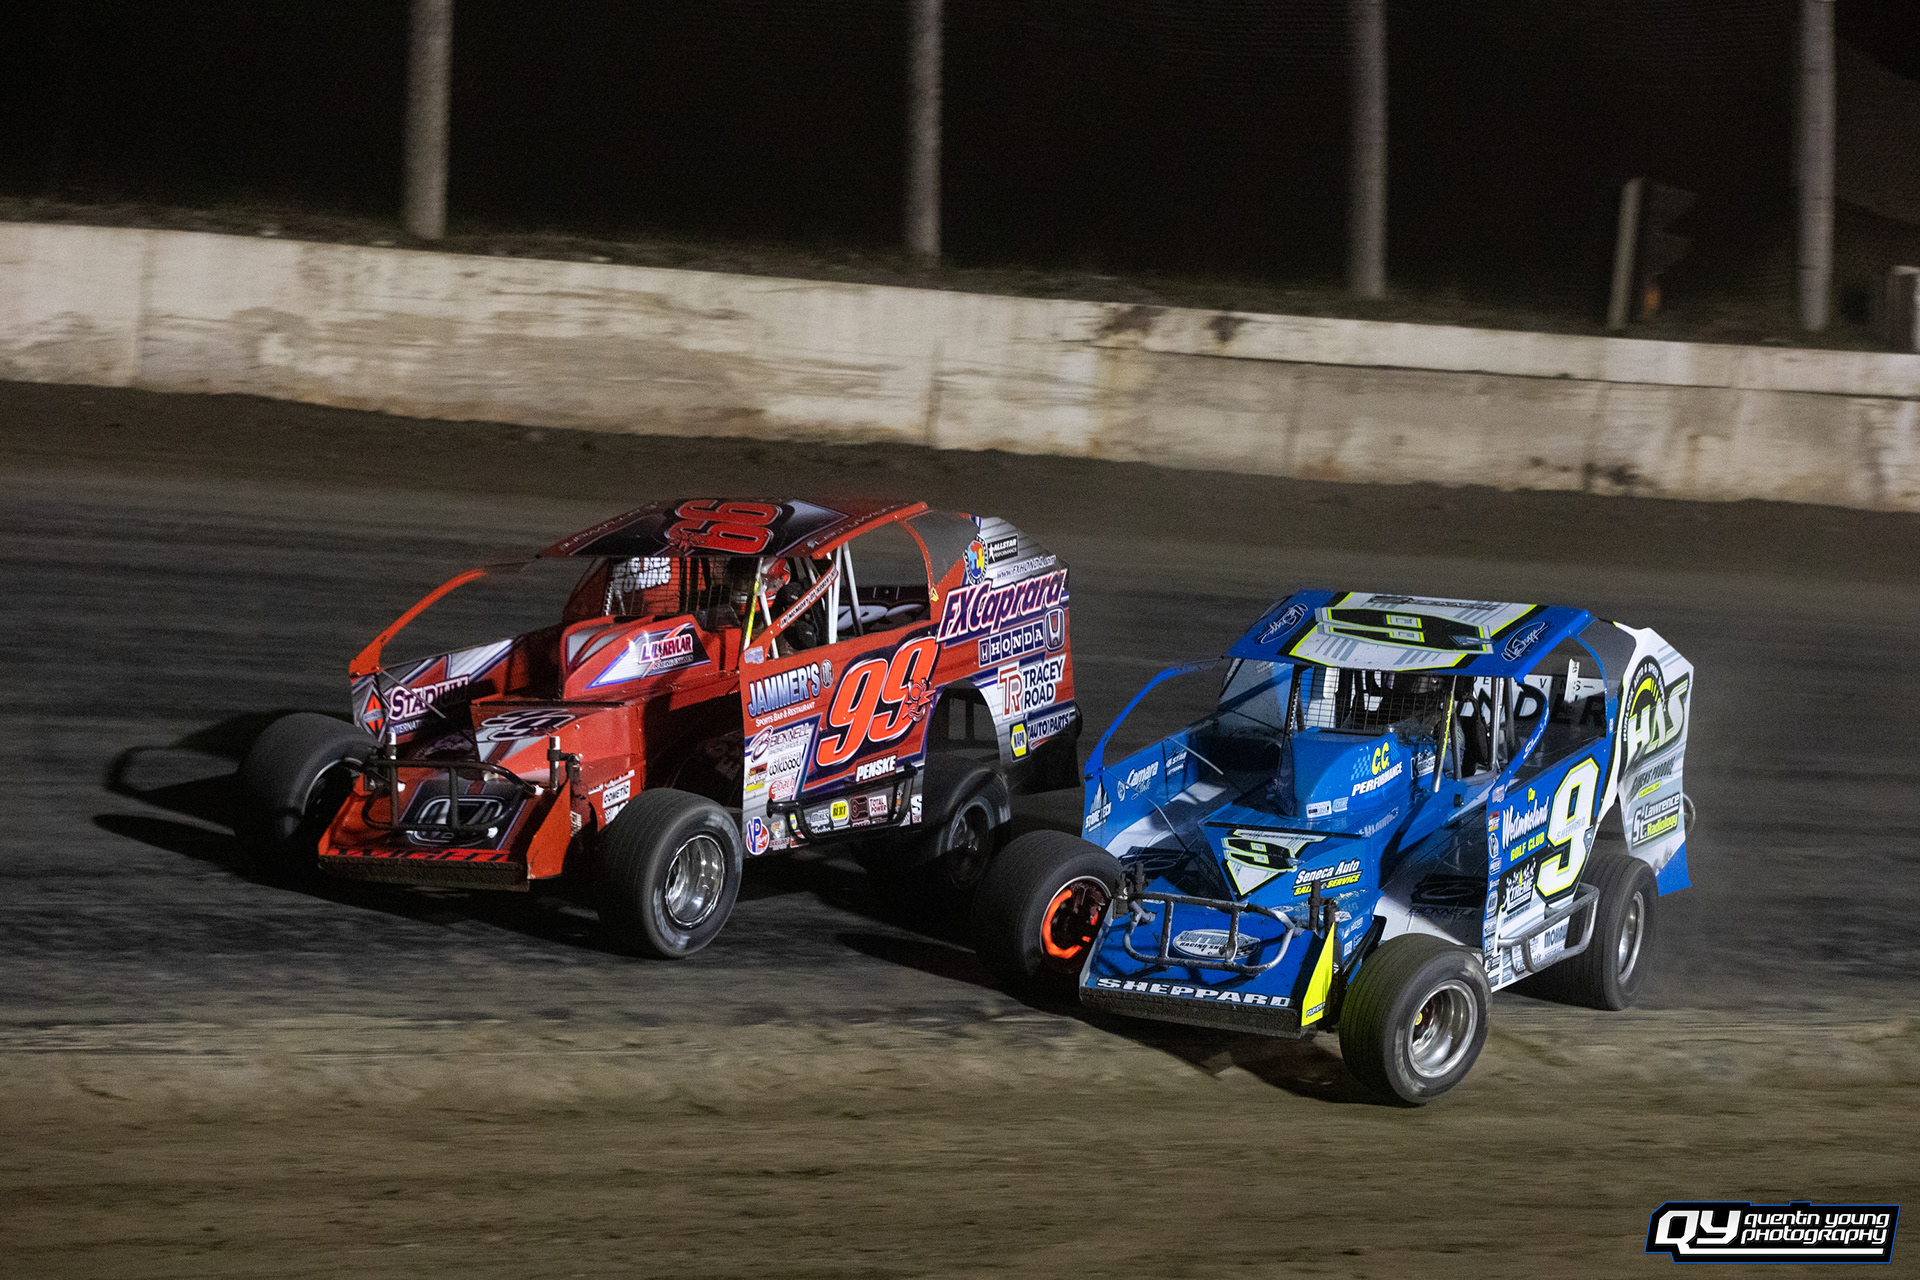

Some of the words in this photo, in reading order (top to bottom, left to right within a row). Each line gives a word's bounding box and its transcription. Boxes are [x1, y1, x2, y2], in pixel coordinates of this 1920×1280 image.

[993, 538, 1017, 552] ALLSTAR
[991, 627, 1044, 657] HONDA
[1023, 658, 1064, 689] TRACEY
[748, 662, 821, 718] JAMMER'S
[817, 636, 942, 767] 99
[1024, 682, 1055, 710] ROAD
[1028, 720, 1049, 740] AUTO
[1049, 712, 1070, 735] PARTS
[856, 755, 897, 783] PENSKE
[1126, 760, 1160, 790] Camara
[1351, 761, 1403, 797] PERFORMANCE
[1645, 793, 1680, 819] Lawrence
[1536, 757, 1600, 898] 9
[1646, 813, 1679, 837] Radiology
[1510, 842, 1527, 861] GOLF
[1527, 832, 1545, 852] CLUB
[1295, 864, 1333, 885] Seneca
[1334, 857, 1362, 876] Auto
[1326, 873, 1362, 889] SERVICE
[1097, 978, 1292, 1008] SHEPPARD
